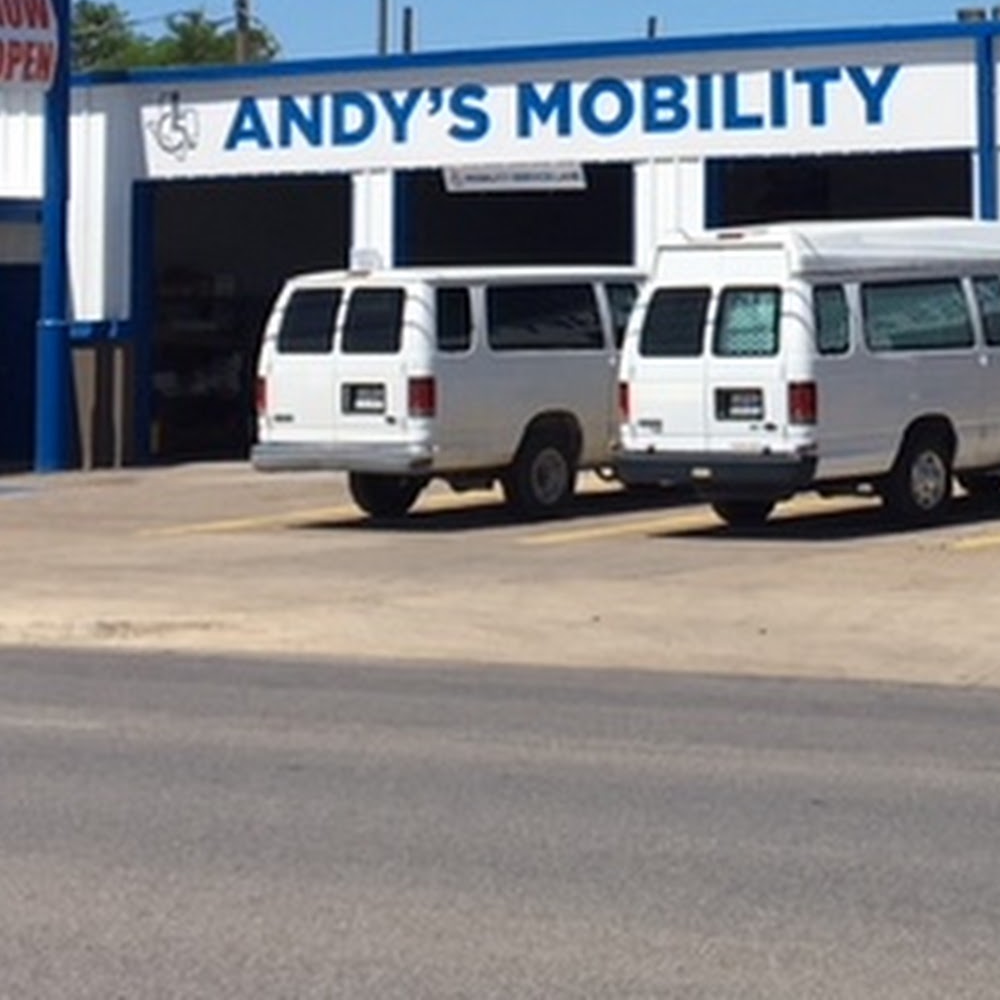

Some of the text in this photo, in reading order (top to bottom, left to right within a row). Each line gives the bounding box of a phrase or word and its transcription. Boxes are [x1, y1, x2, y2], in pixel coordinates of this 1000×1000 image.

[0, 40, 54, 82] PEN
[223, 63, 902, 151] ANDY'S MOBILITY
